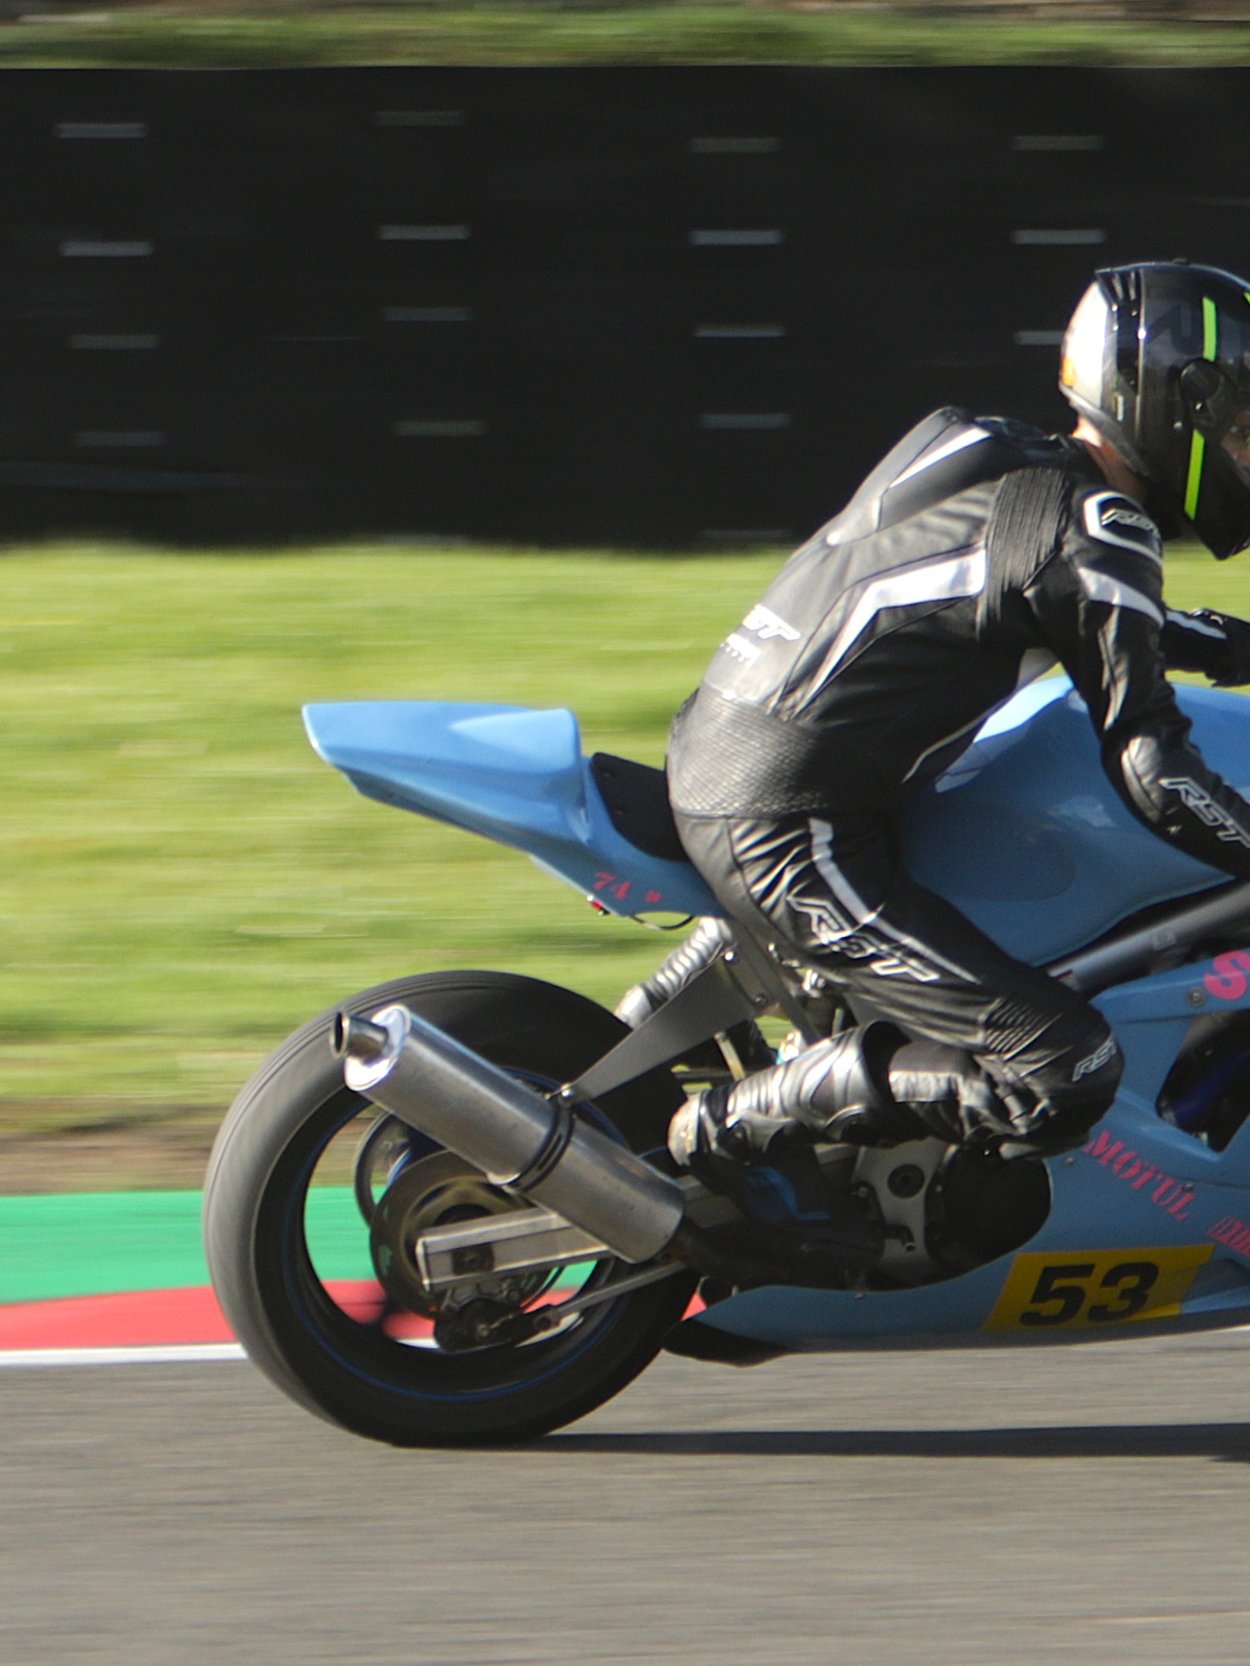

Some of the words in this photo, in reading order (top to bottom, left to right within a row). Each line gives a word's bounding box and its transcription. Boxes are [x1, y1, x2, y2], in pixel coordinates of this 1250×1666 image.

[787, 897, 940, 982] RST
[1083, 1130, 1195, 1221] MOTUL
[1020, 1262, 1158, 1326] 53
